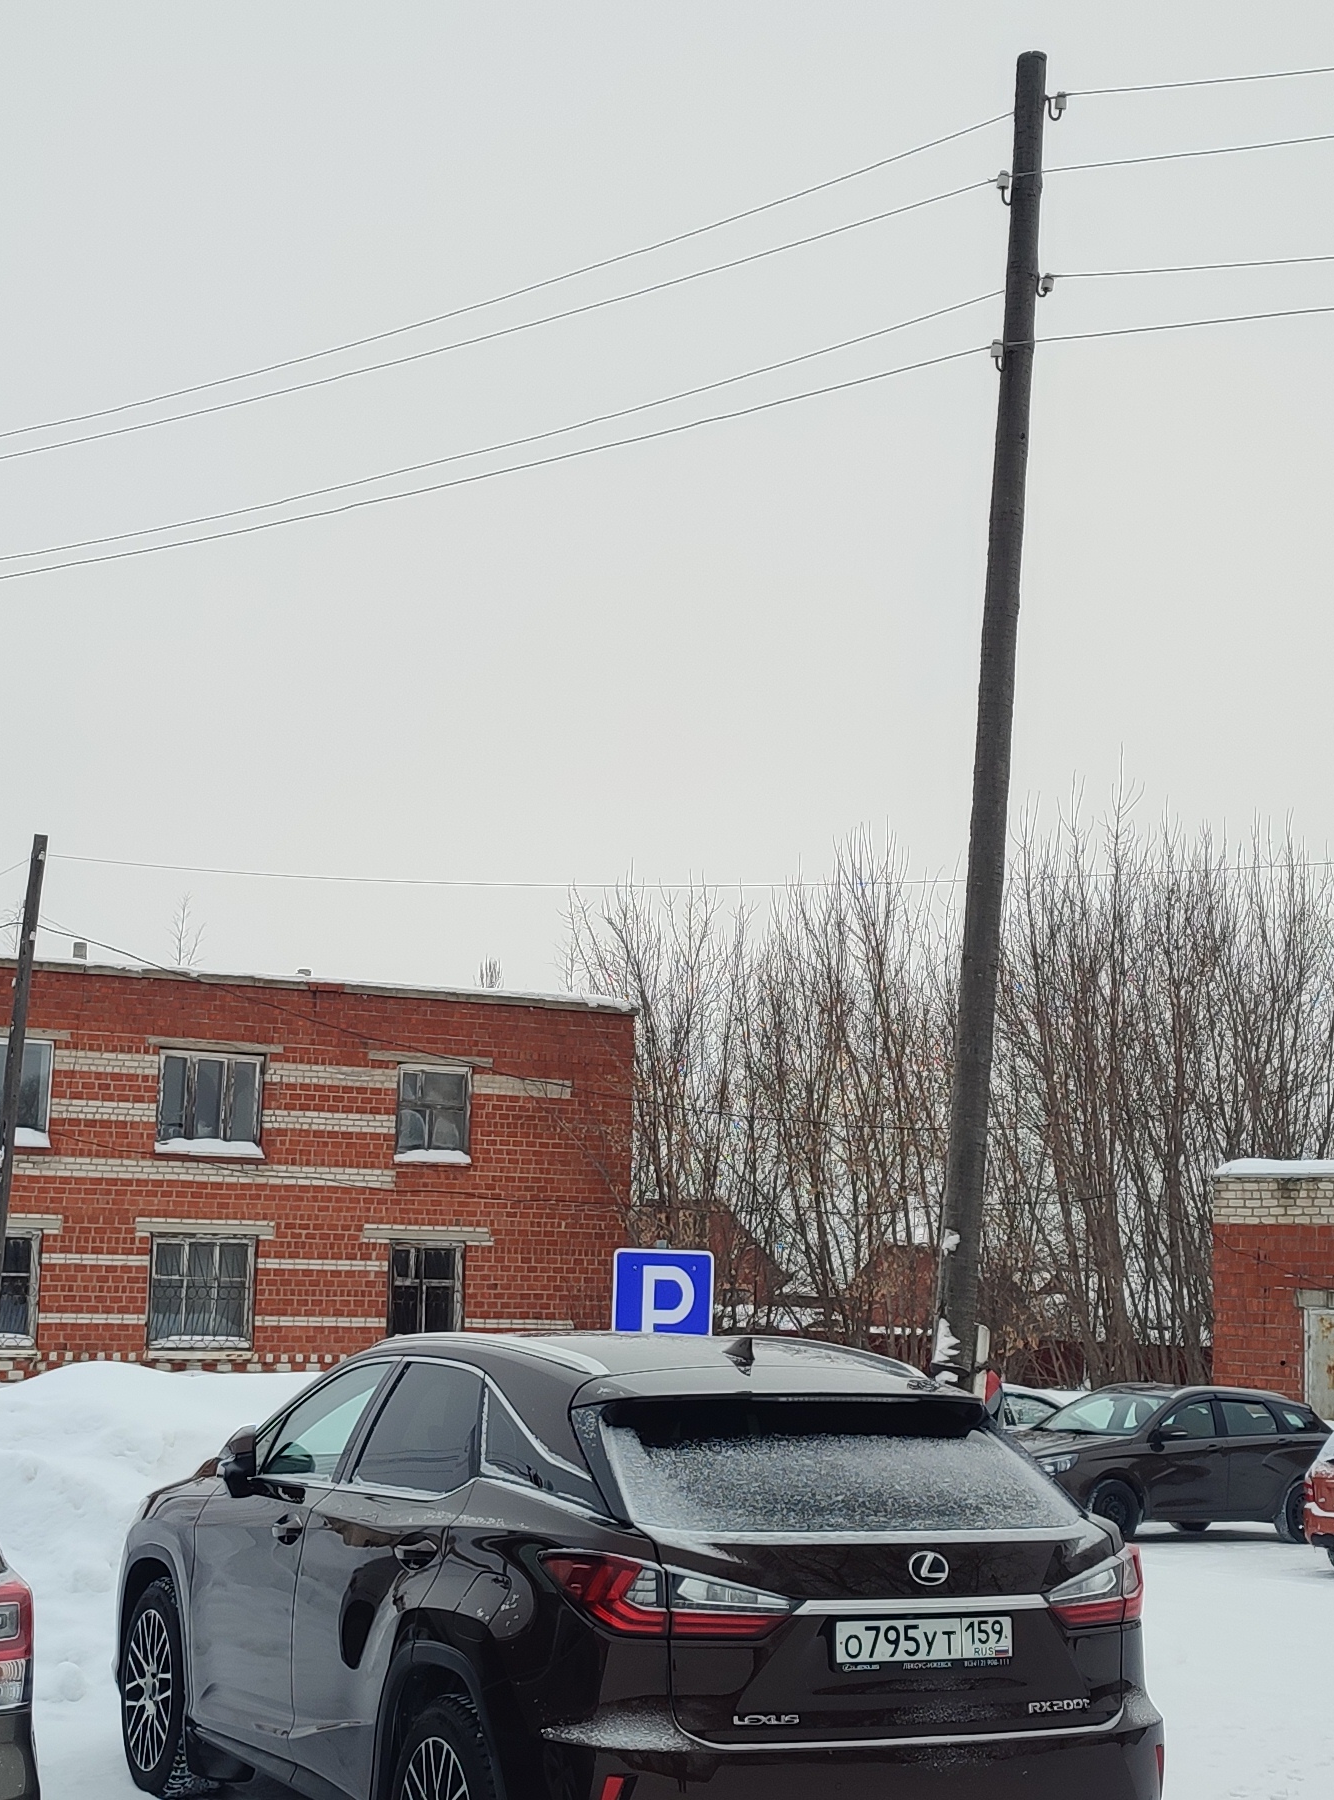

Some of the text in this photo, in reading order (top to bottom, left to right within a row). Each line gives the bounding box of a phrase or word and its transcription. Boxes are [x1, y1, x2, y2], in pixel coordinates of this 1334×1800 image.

[641, 1264, 695, 1333] P
[964, 1619, 1004, 1647] 159
[973, 1646, 994, 1657] RUS
[733, 1714, 800, 1726] LEXUS
